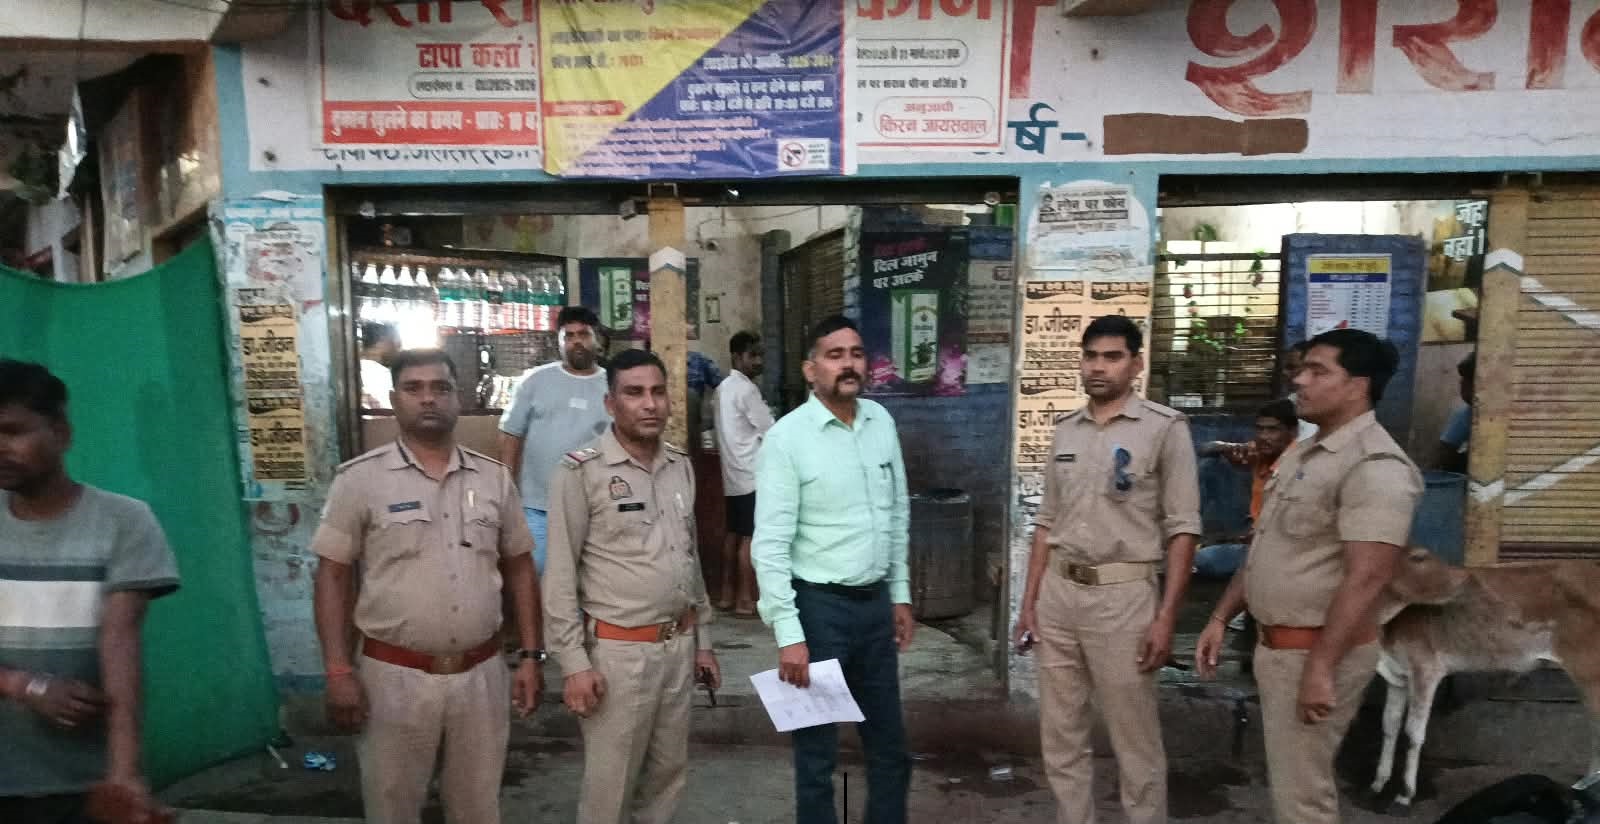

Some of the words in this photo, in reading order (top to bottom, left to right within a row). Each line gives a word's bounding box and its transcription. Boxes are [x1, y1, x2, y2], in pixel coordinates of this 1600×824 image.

[416, 43, 462, 67] टापा
[470, 35, 521, 67] कलां
[869, 79, 881, 88] पर
[883, 79, 906, 88] शराब
[908, 77, 929, 88] पीना
[959, 77, 967, 88] है
[409, 110, 427, 130] का
[428, 110, 463, 131] समय
[1007, 102, 1088, 155] र्ष-
[872, 257, 899, 273] दिल
[899, 250, 939, 269] जामुन
